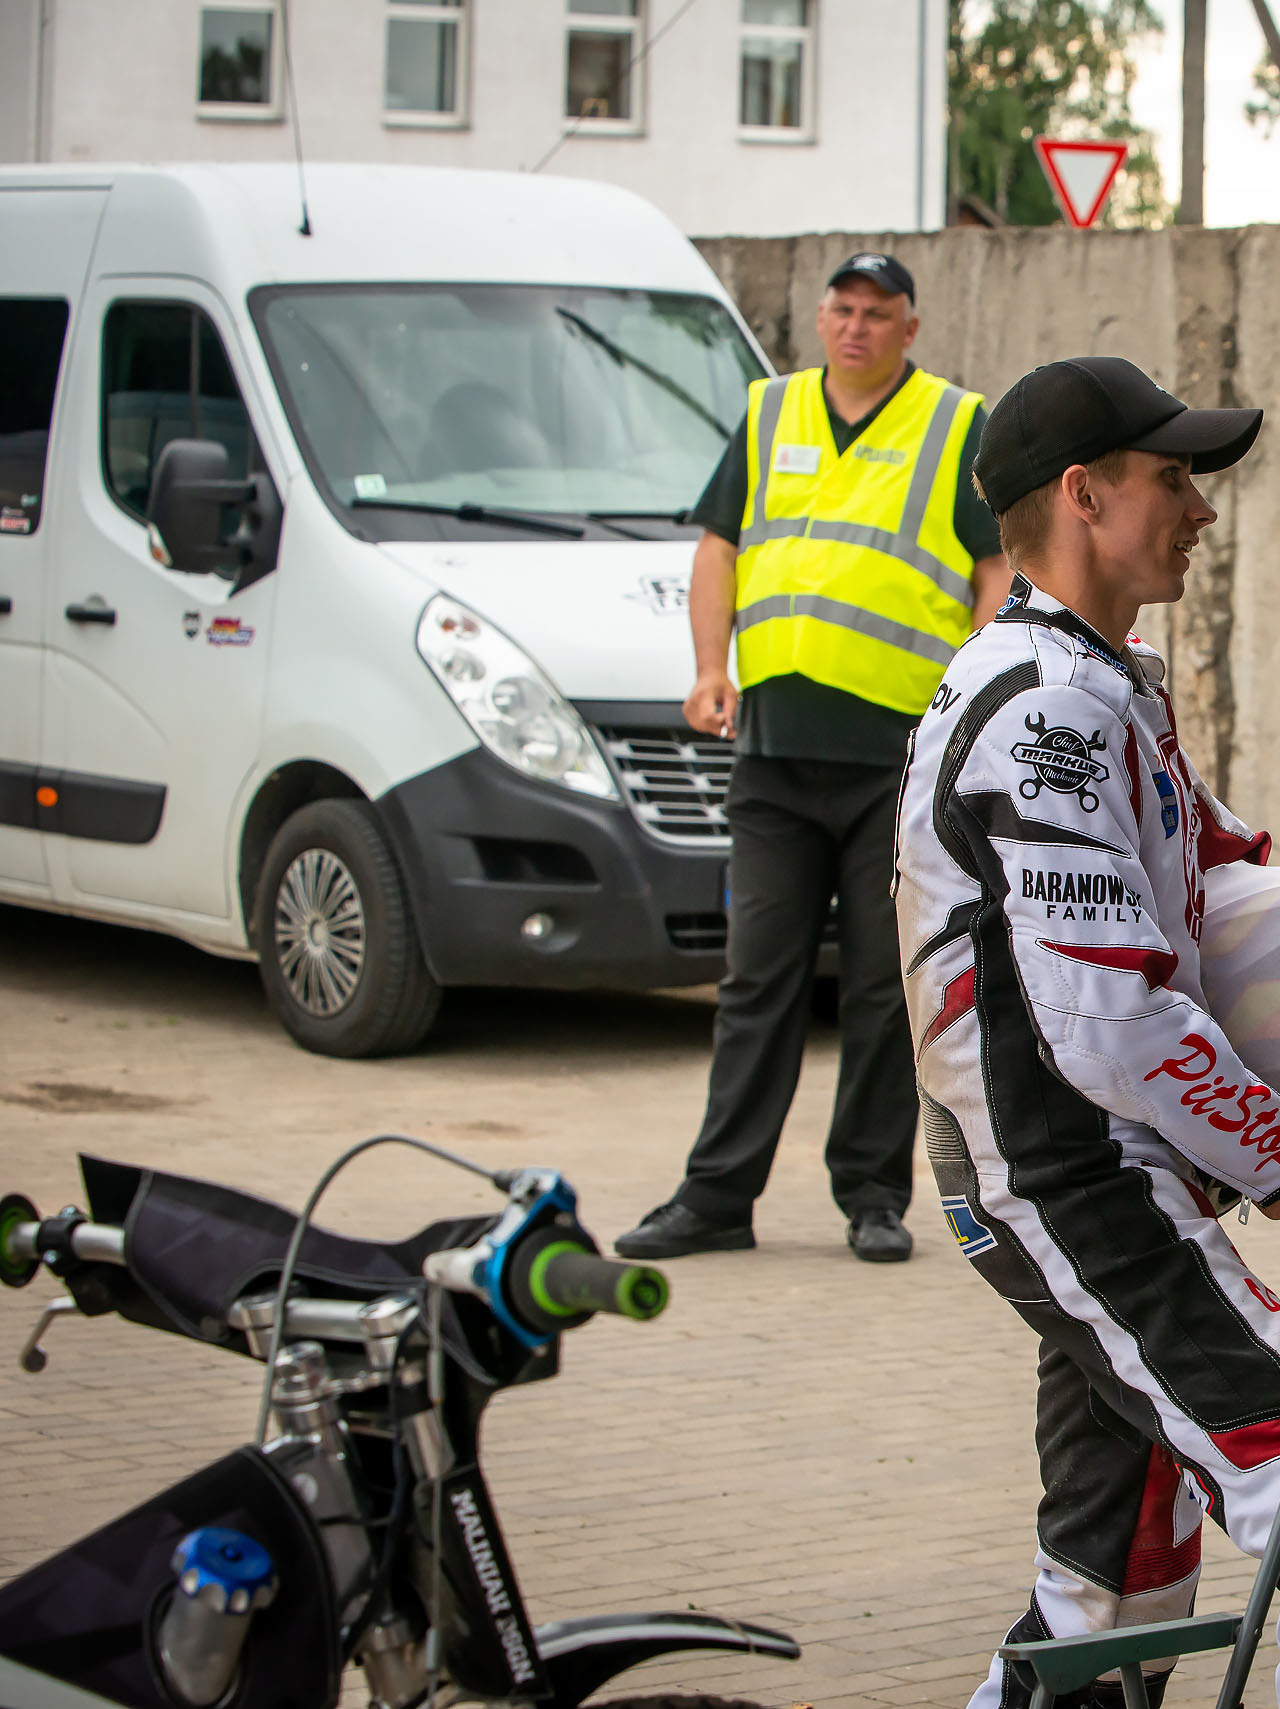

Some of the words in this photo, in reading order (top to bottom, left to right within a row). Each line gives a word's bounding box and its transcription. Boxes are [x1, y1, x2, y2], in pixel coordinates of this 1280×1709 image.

[1020, 747, 1101, 777] MARKUS
[1043, 766, 1079, 784] Mechanic
[1046, 904, 1142, 924] FAMILY
